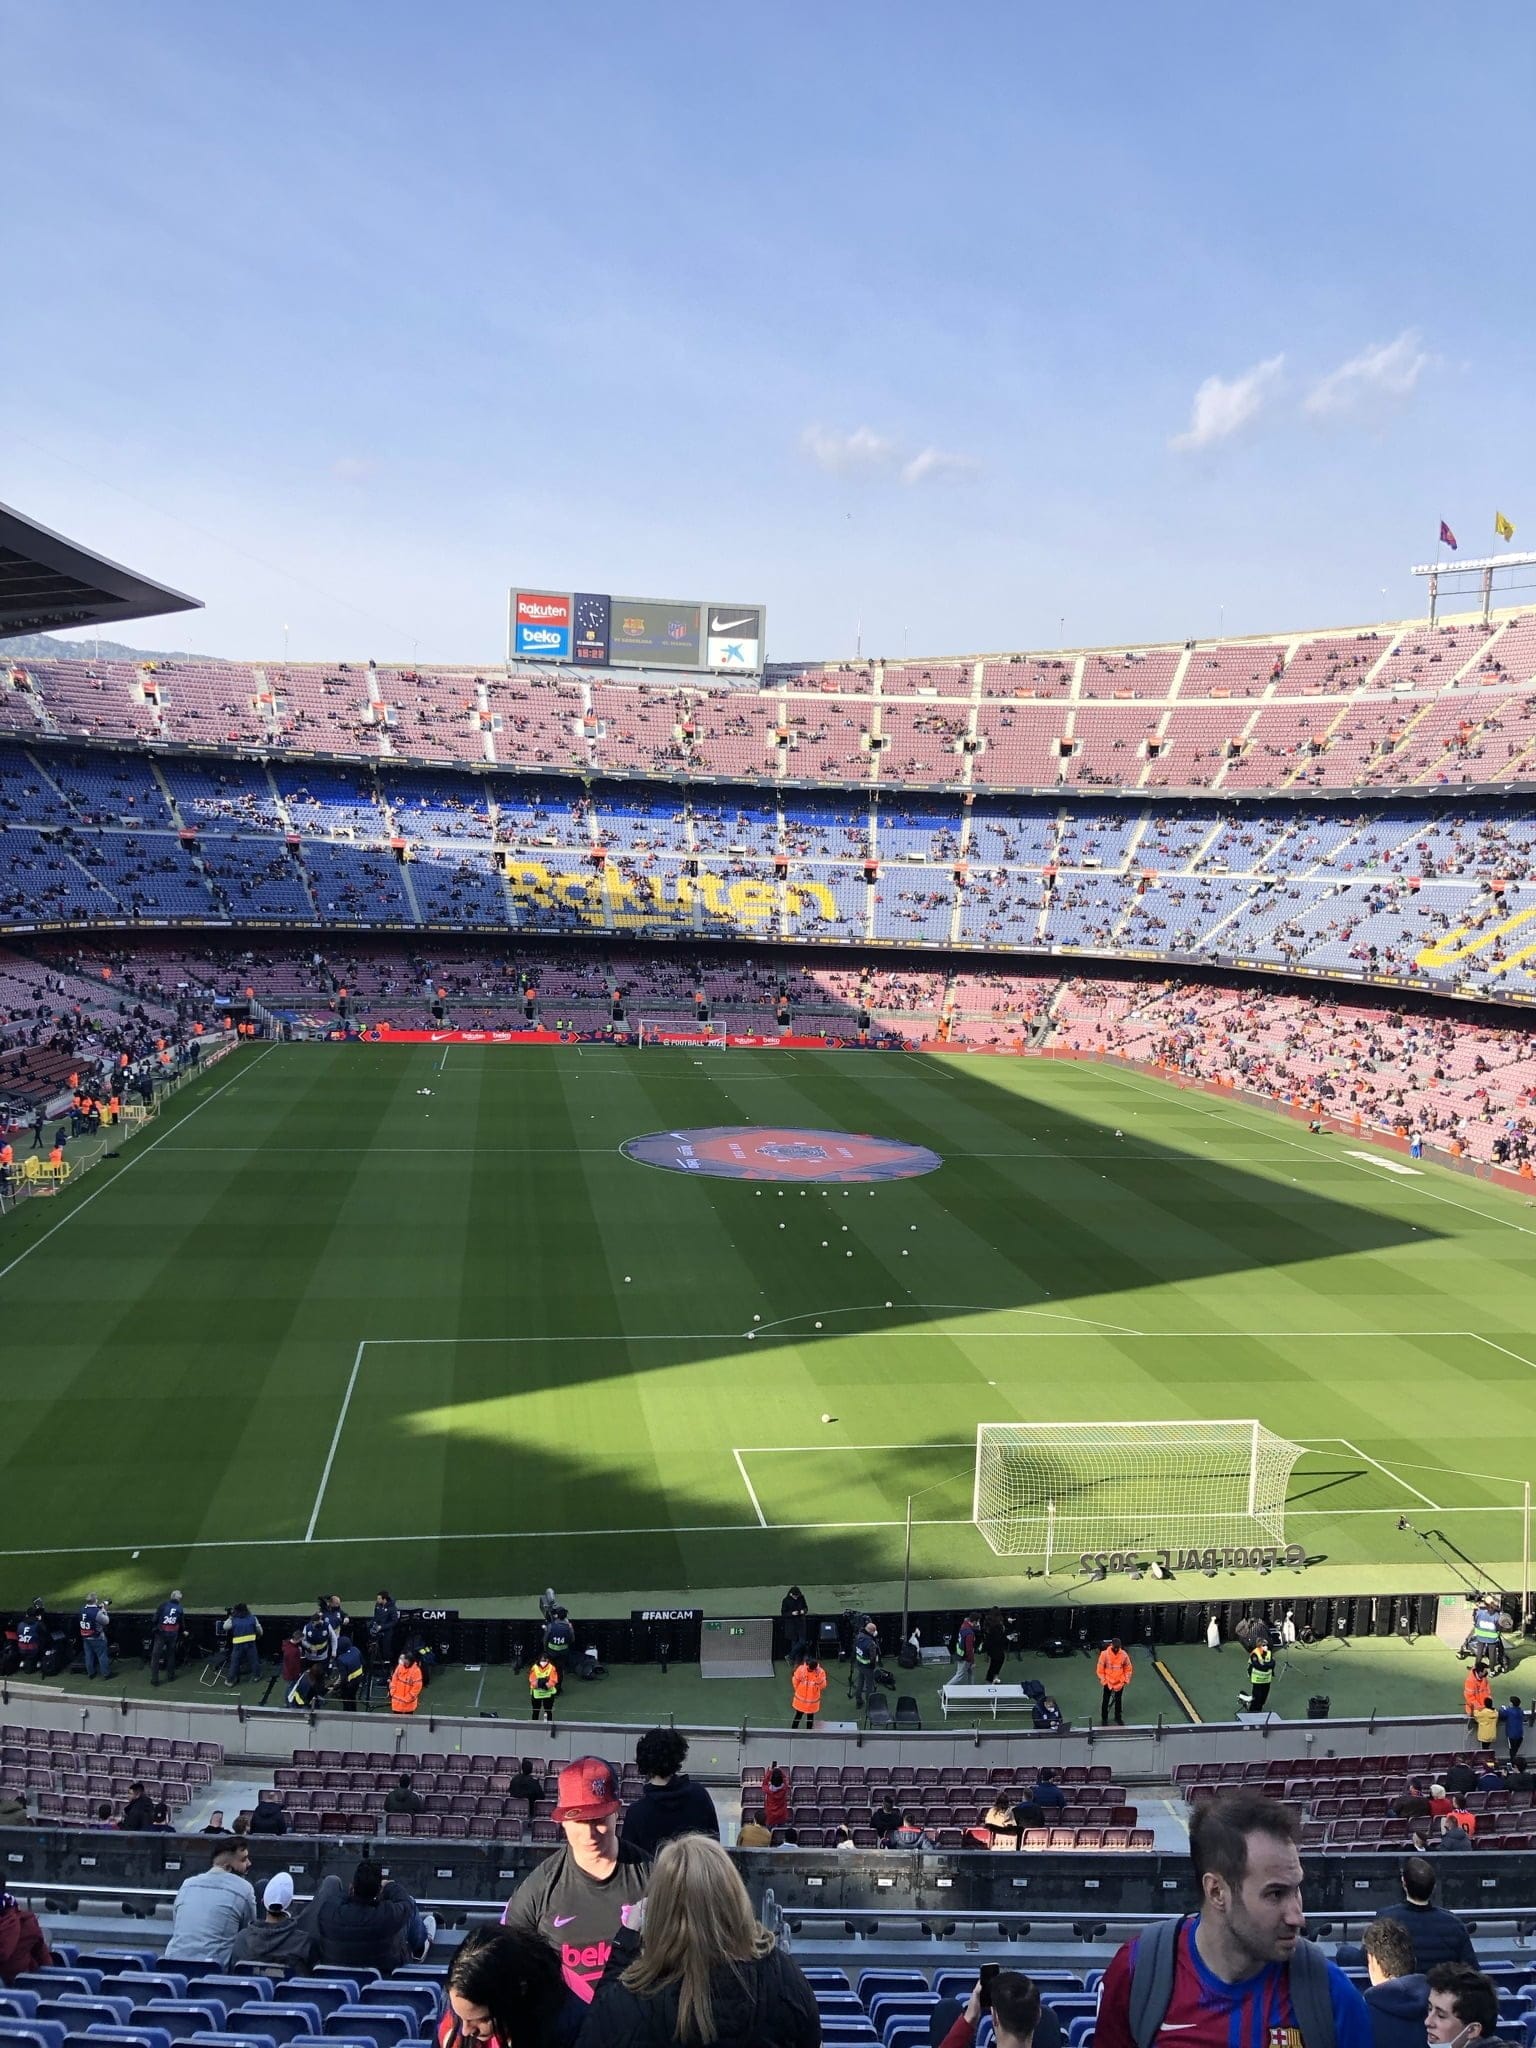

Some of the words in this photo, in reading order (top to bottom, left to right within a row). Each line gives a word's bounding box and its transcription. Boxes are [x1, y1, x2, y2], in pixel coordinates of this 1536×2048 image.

[519, 602, 567, 618] Rakuten
[523, 628, 561, 644] beko
[506, 862, 838, 920] Rakuten
[169, 1608, 177, 1616] F
[641, 1610, 693, 1620] #FANCAM
[23, 1626, 30, 1635] F
[553, 1636, 565, 1645] 114
[562, 1942, 612, 1967] bek
